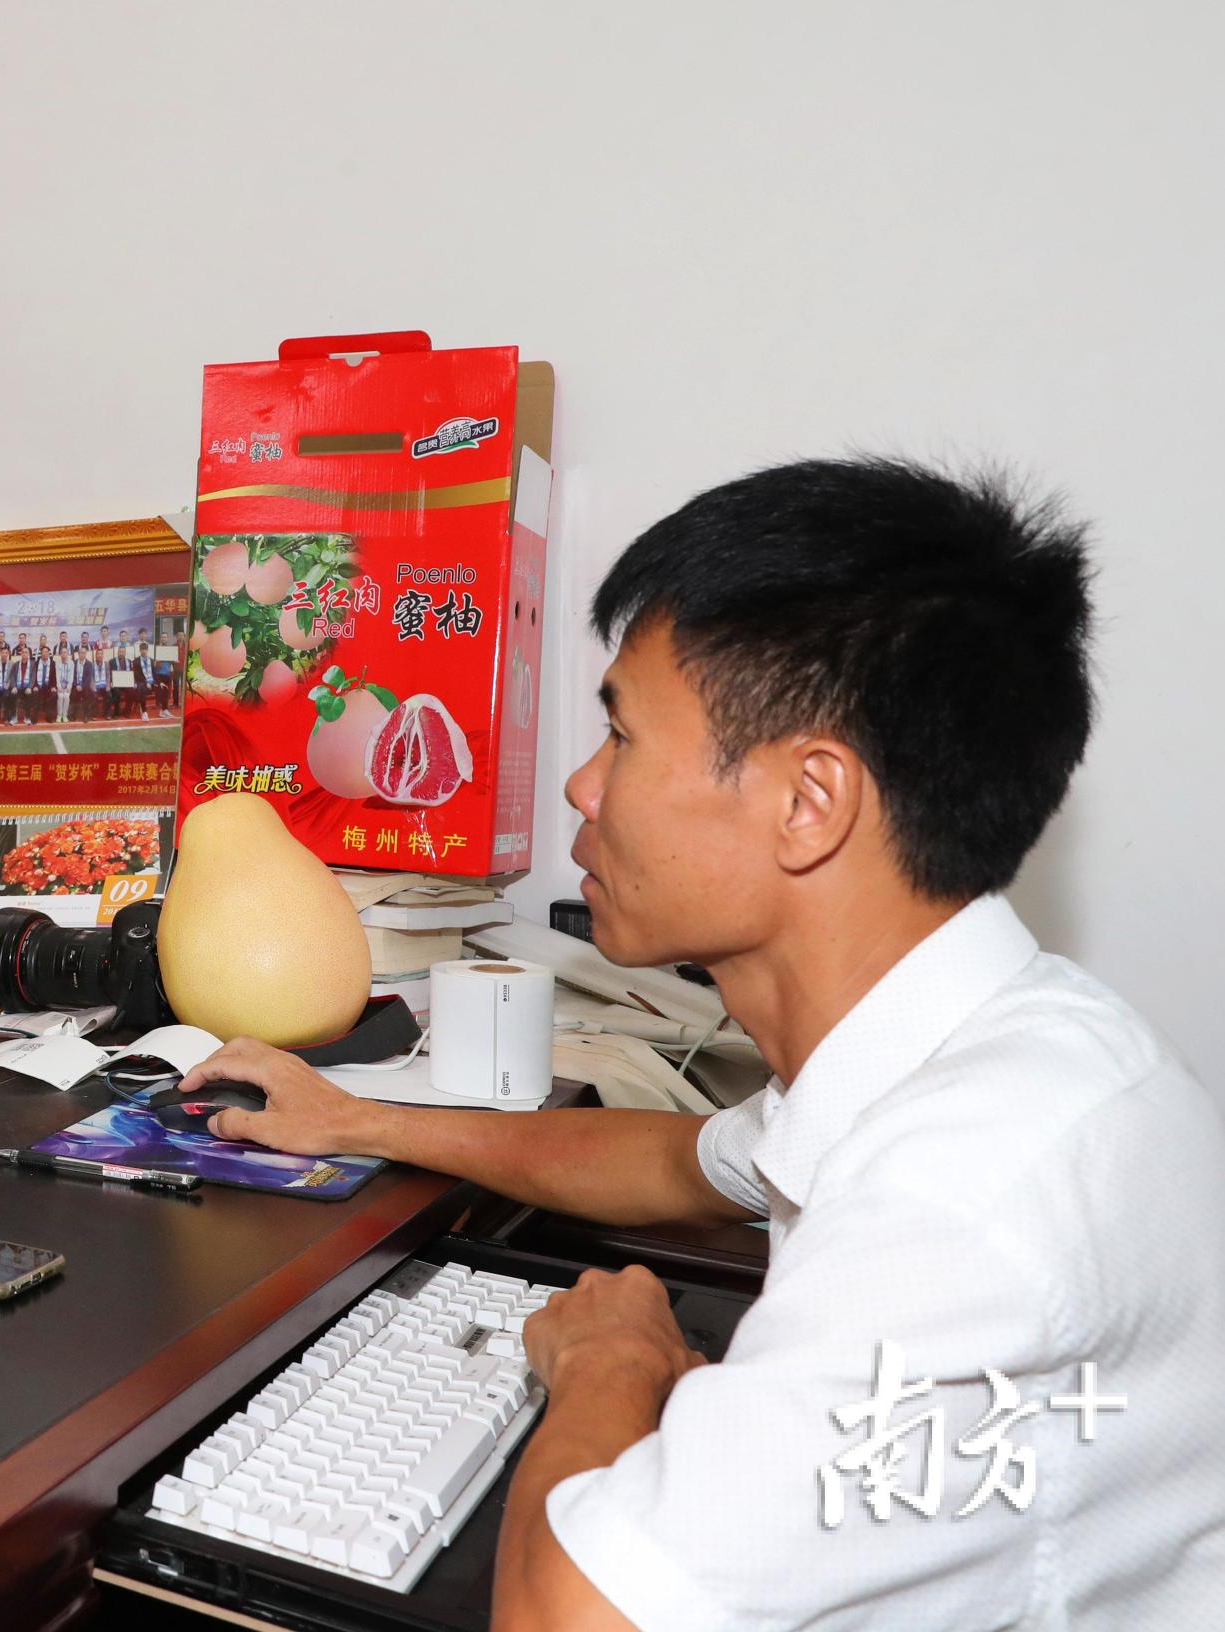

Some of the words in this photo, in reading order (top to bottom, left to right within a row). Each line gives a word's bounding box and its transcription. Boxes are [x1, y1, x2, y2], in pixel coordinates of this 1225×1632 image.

[249, 441, 283, 463] 蜜柚
[396, 564, 477, 586] Poenlo
[282, 576, 381, 615] 三红肉
[393, 589, 483, 642] 蜜柚
[312, 618, 356, 639] Red
[193, 764, 302, 795] 美味柚惑
[342, 825, 468, 858] 梅州特产
[109, 878, 149, 903] 09
[102, 907, 120, 916] 201
